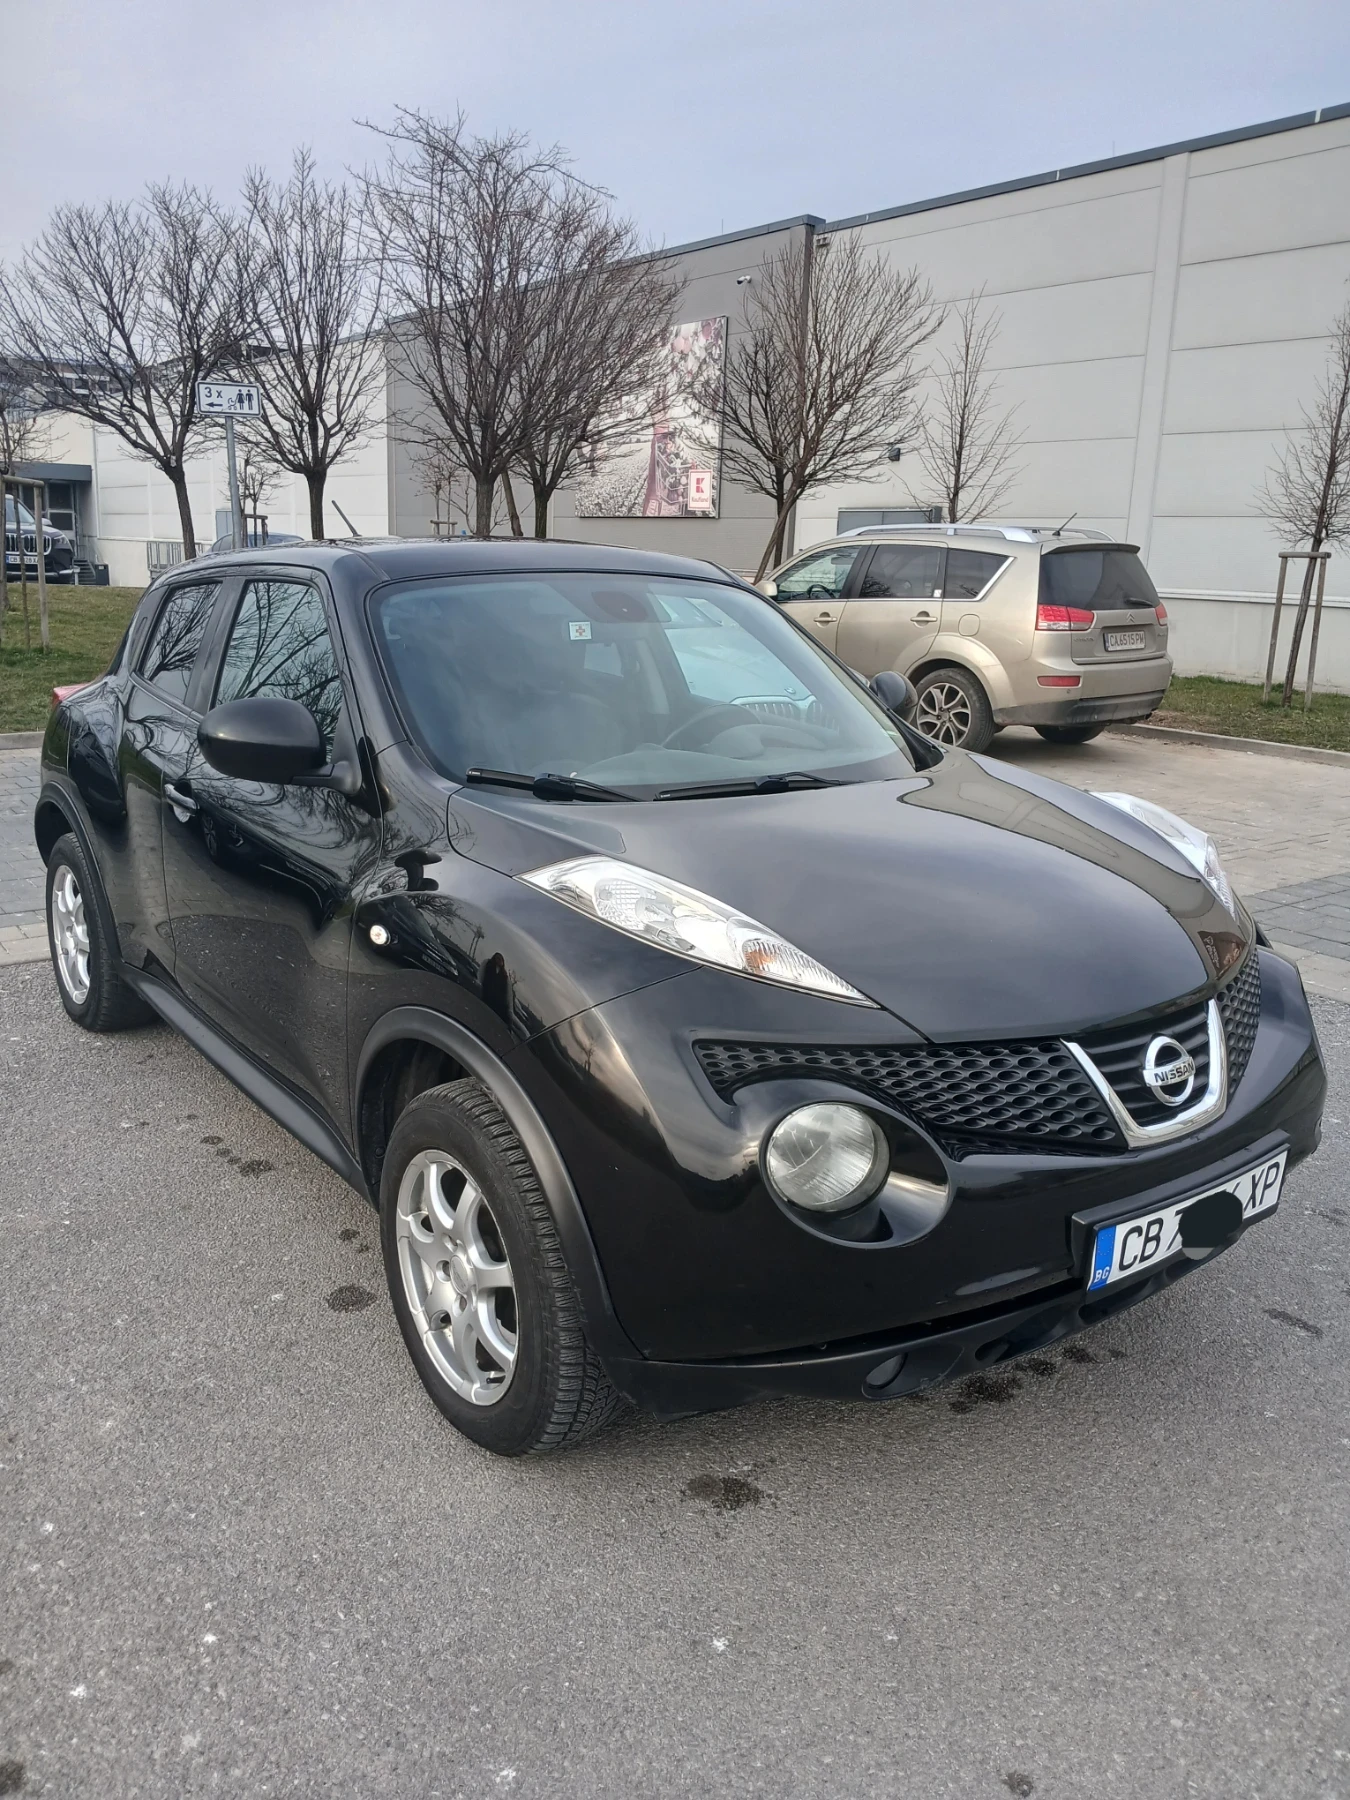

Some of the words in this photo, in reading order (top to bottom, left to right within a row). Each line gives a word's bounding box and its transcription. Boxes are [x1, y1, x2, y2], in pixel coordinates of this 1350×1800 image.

[204, 386, 212, 398] 3
[1154, 1062, 1194, 1083] NISSAN
[1118, 1217, 1164, 1272] CB
[1243, 1161, 1280, 1213] XP
[1094, 1266, 1110, 1283] BG
